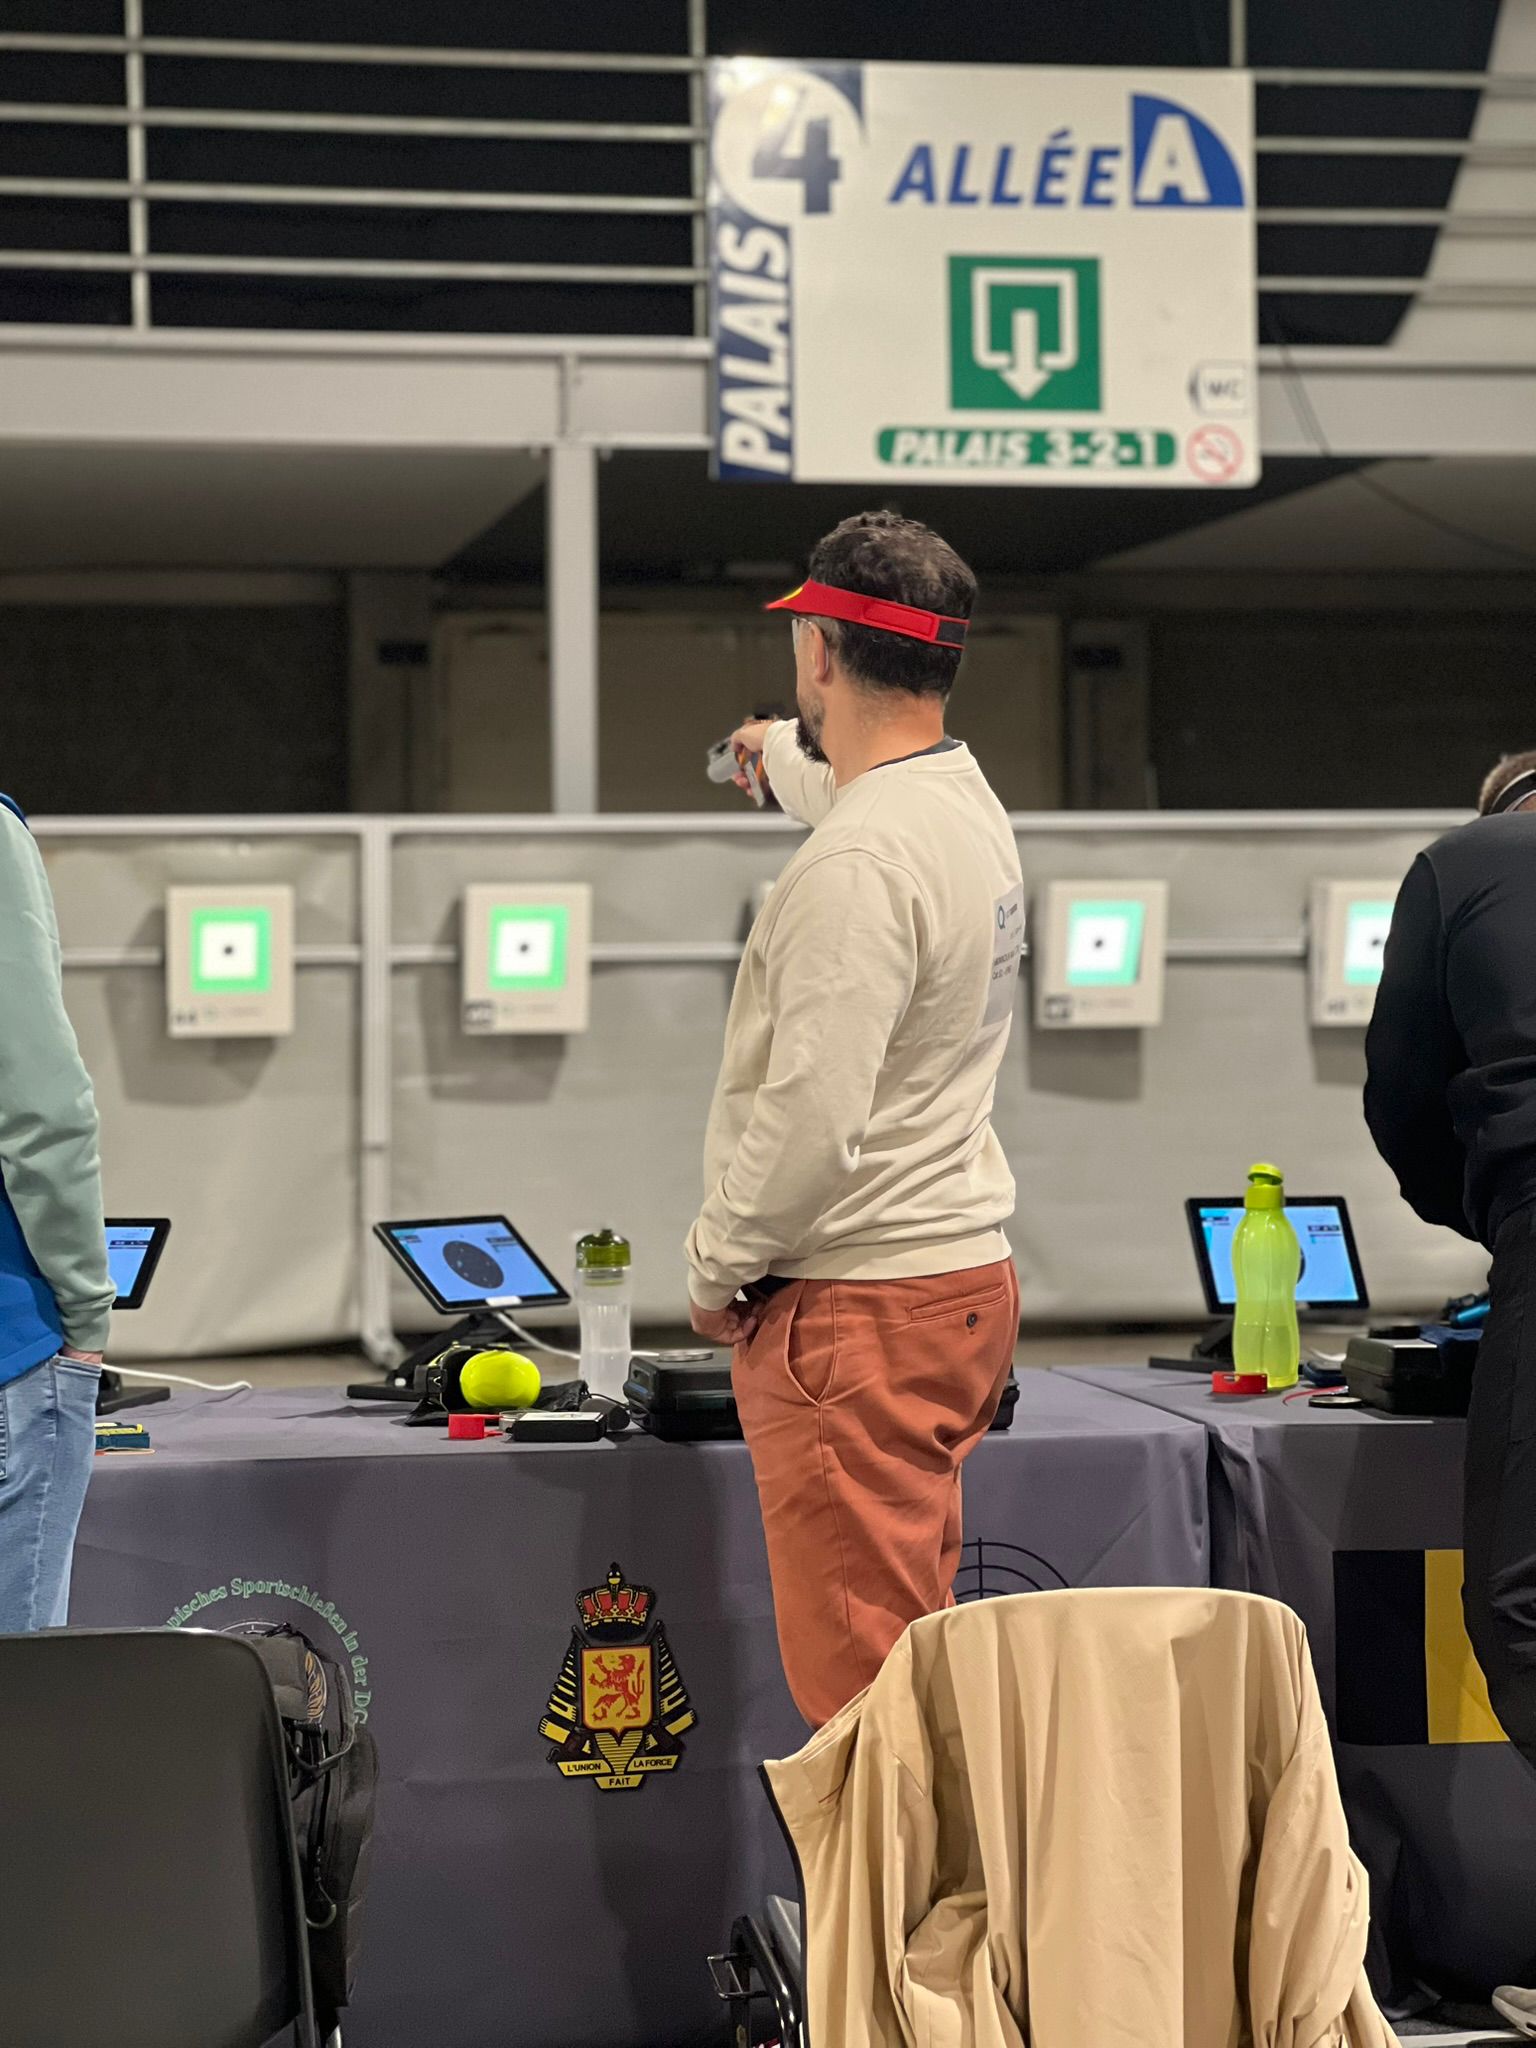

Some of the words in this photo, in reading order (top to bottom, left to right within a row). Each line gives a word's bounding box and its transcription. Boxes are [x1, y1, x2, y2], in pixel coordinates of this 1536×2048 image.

[751, 88, 841, 215] 4
[888, 128, 1123, 208] ALLÉE
[1134, 112, 1212, 203] A
[717, 224, 791, 474] PALAIS
[891, 430, 1030, 466] PALAIS
[230, 1577, 348, 1635] Sportschießen
[341, 1630, 359, 1653] in
[350, 1654, 369, 1687] der
[566, 1761, 601, 1773] L'UNION
[608, 1775, 632, 1787] FAIT
[633, 1759, 645, 1768] LA
[646, 1757, 673, 1768] FORCE
